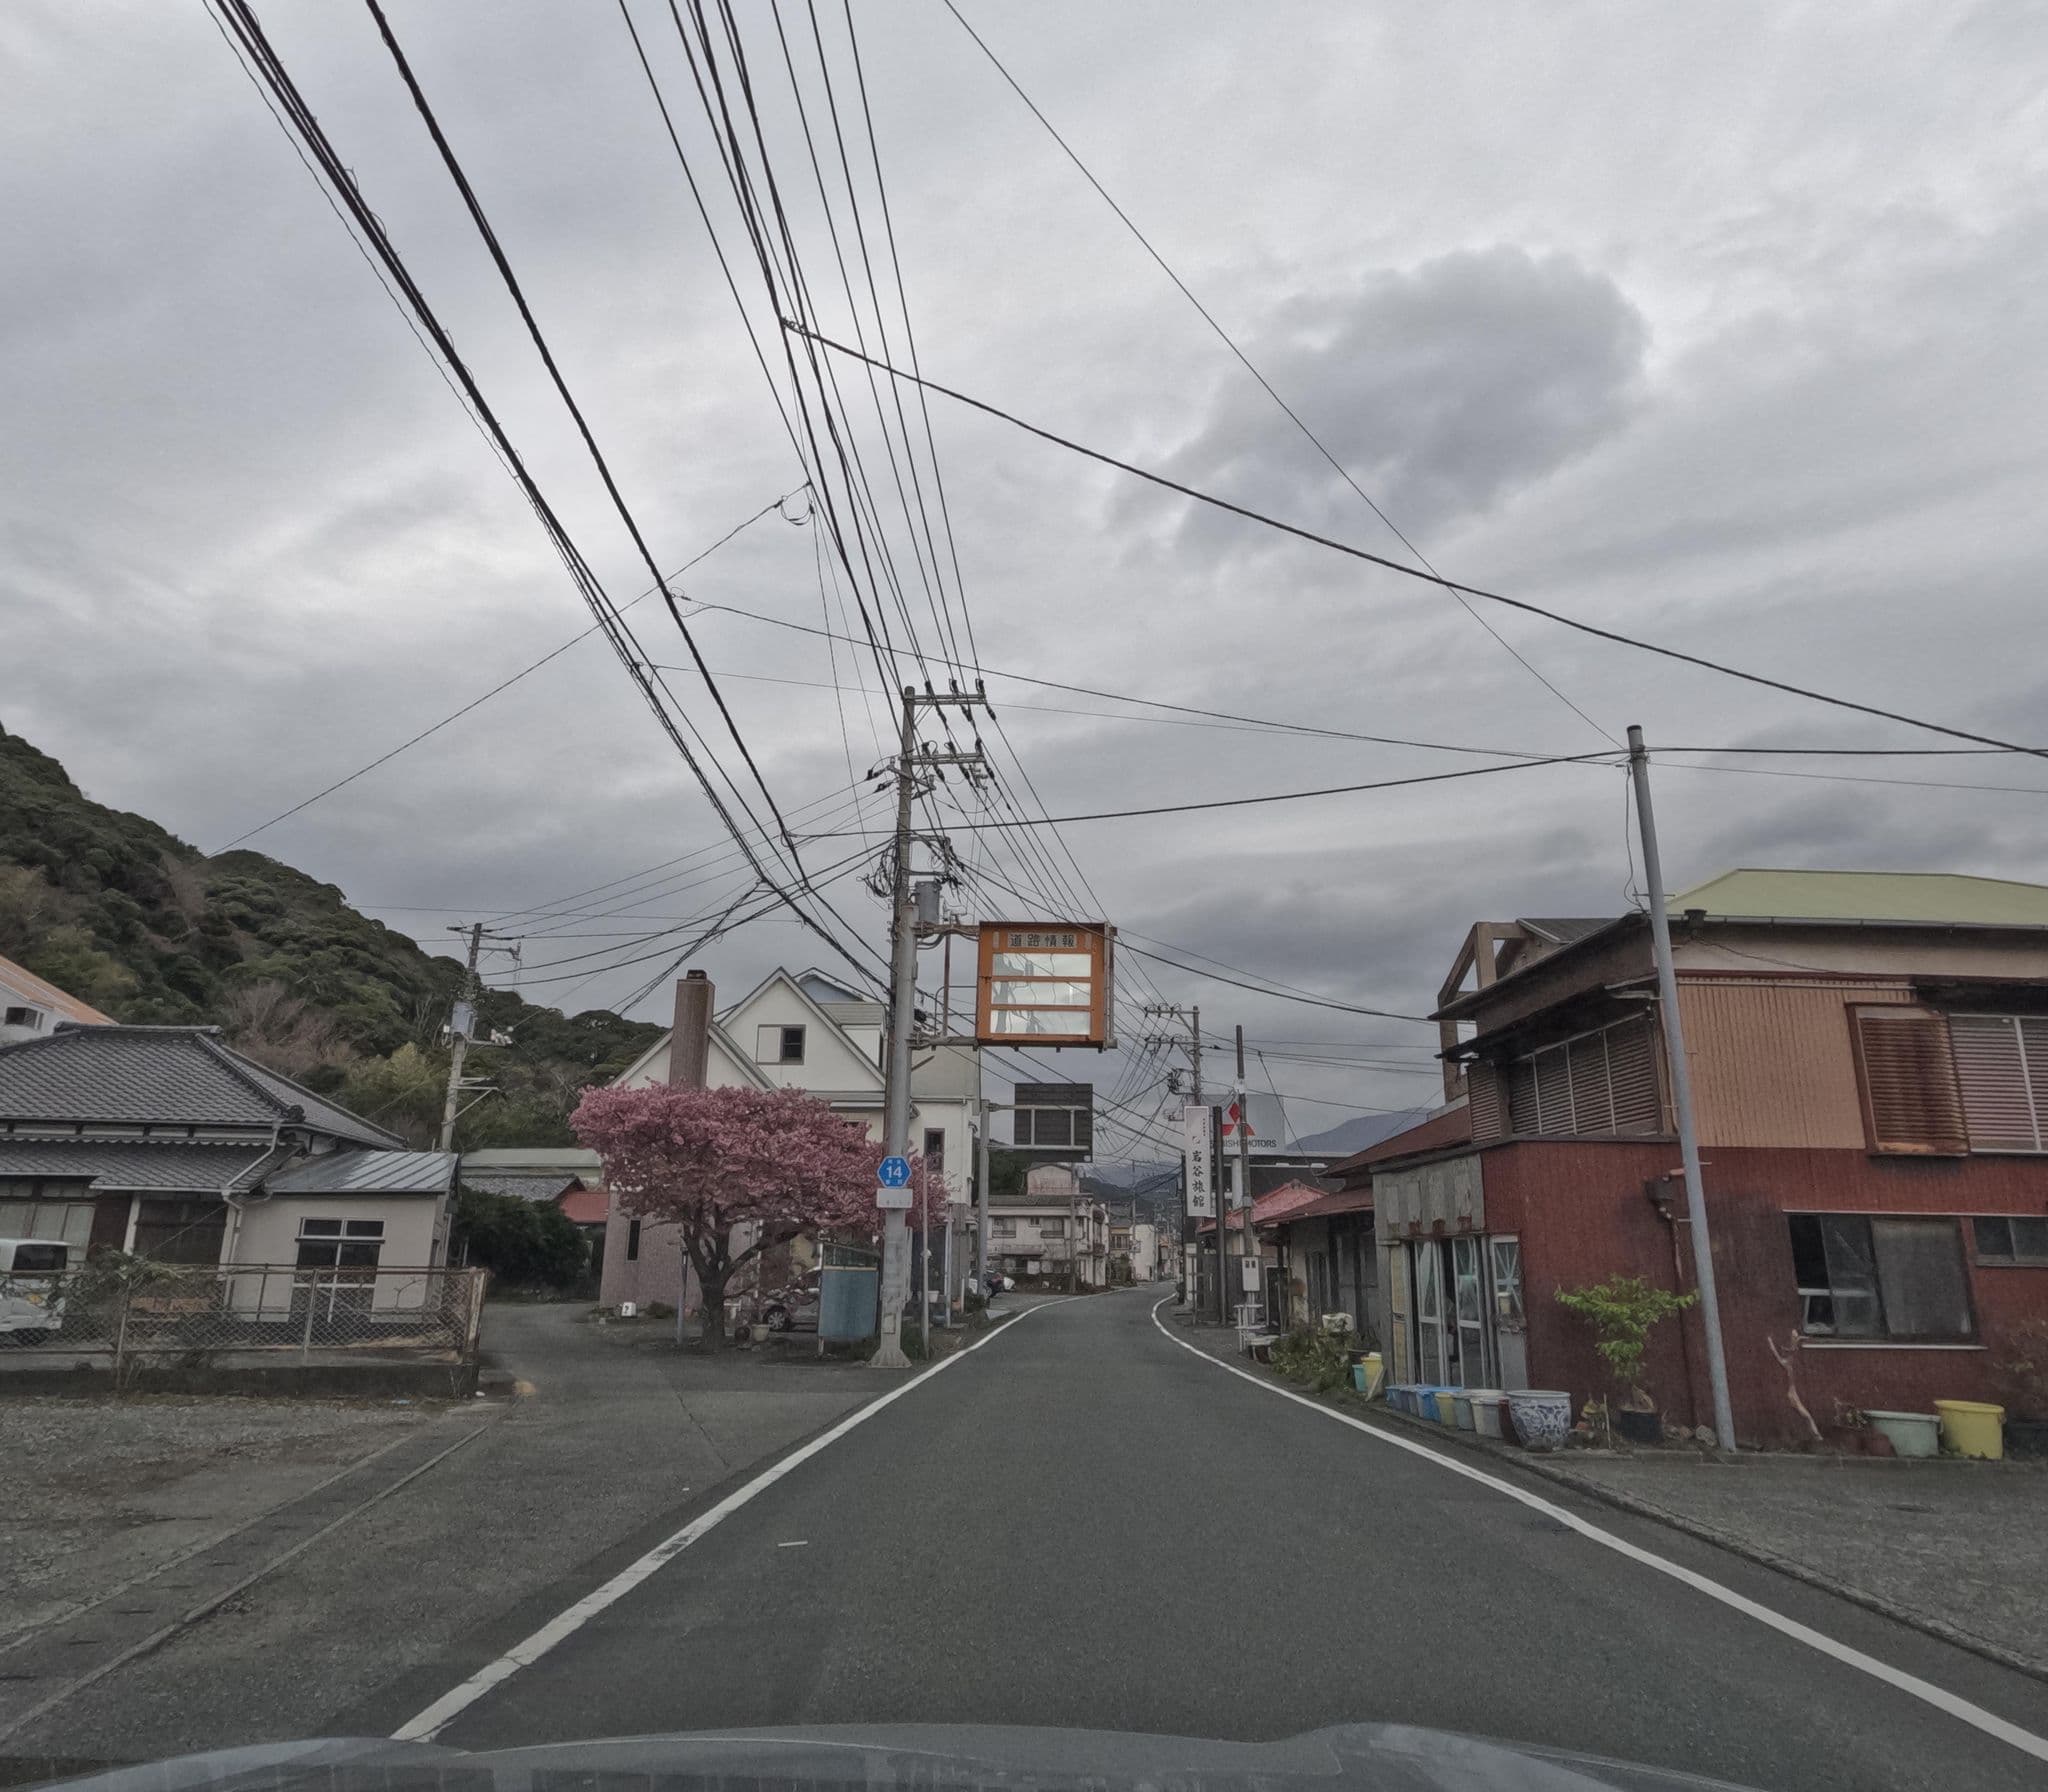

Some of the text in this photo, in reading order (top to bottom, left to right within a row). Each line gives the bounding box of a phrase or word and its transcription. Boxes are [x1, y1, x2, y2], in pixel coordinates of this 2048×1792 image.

[1010, 934, 1074, 947] 道路情報
[886, 1166, 903, 1178] 14
